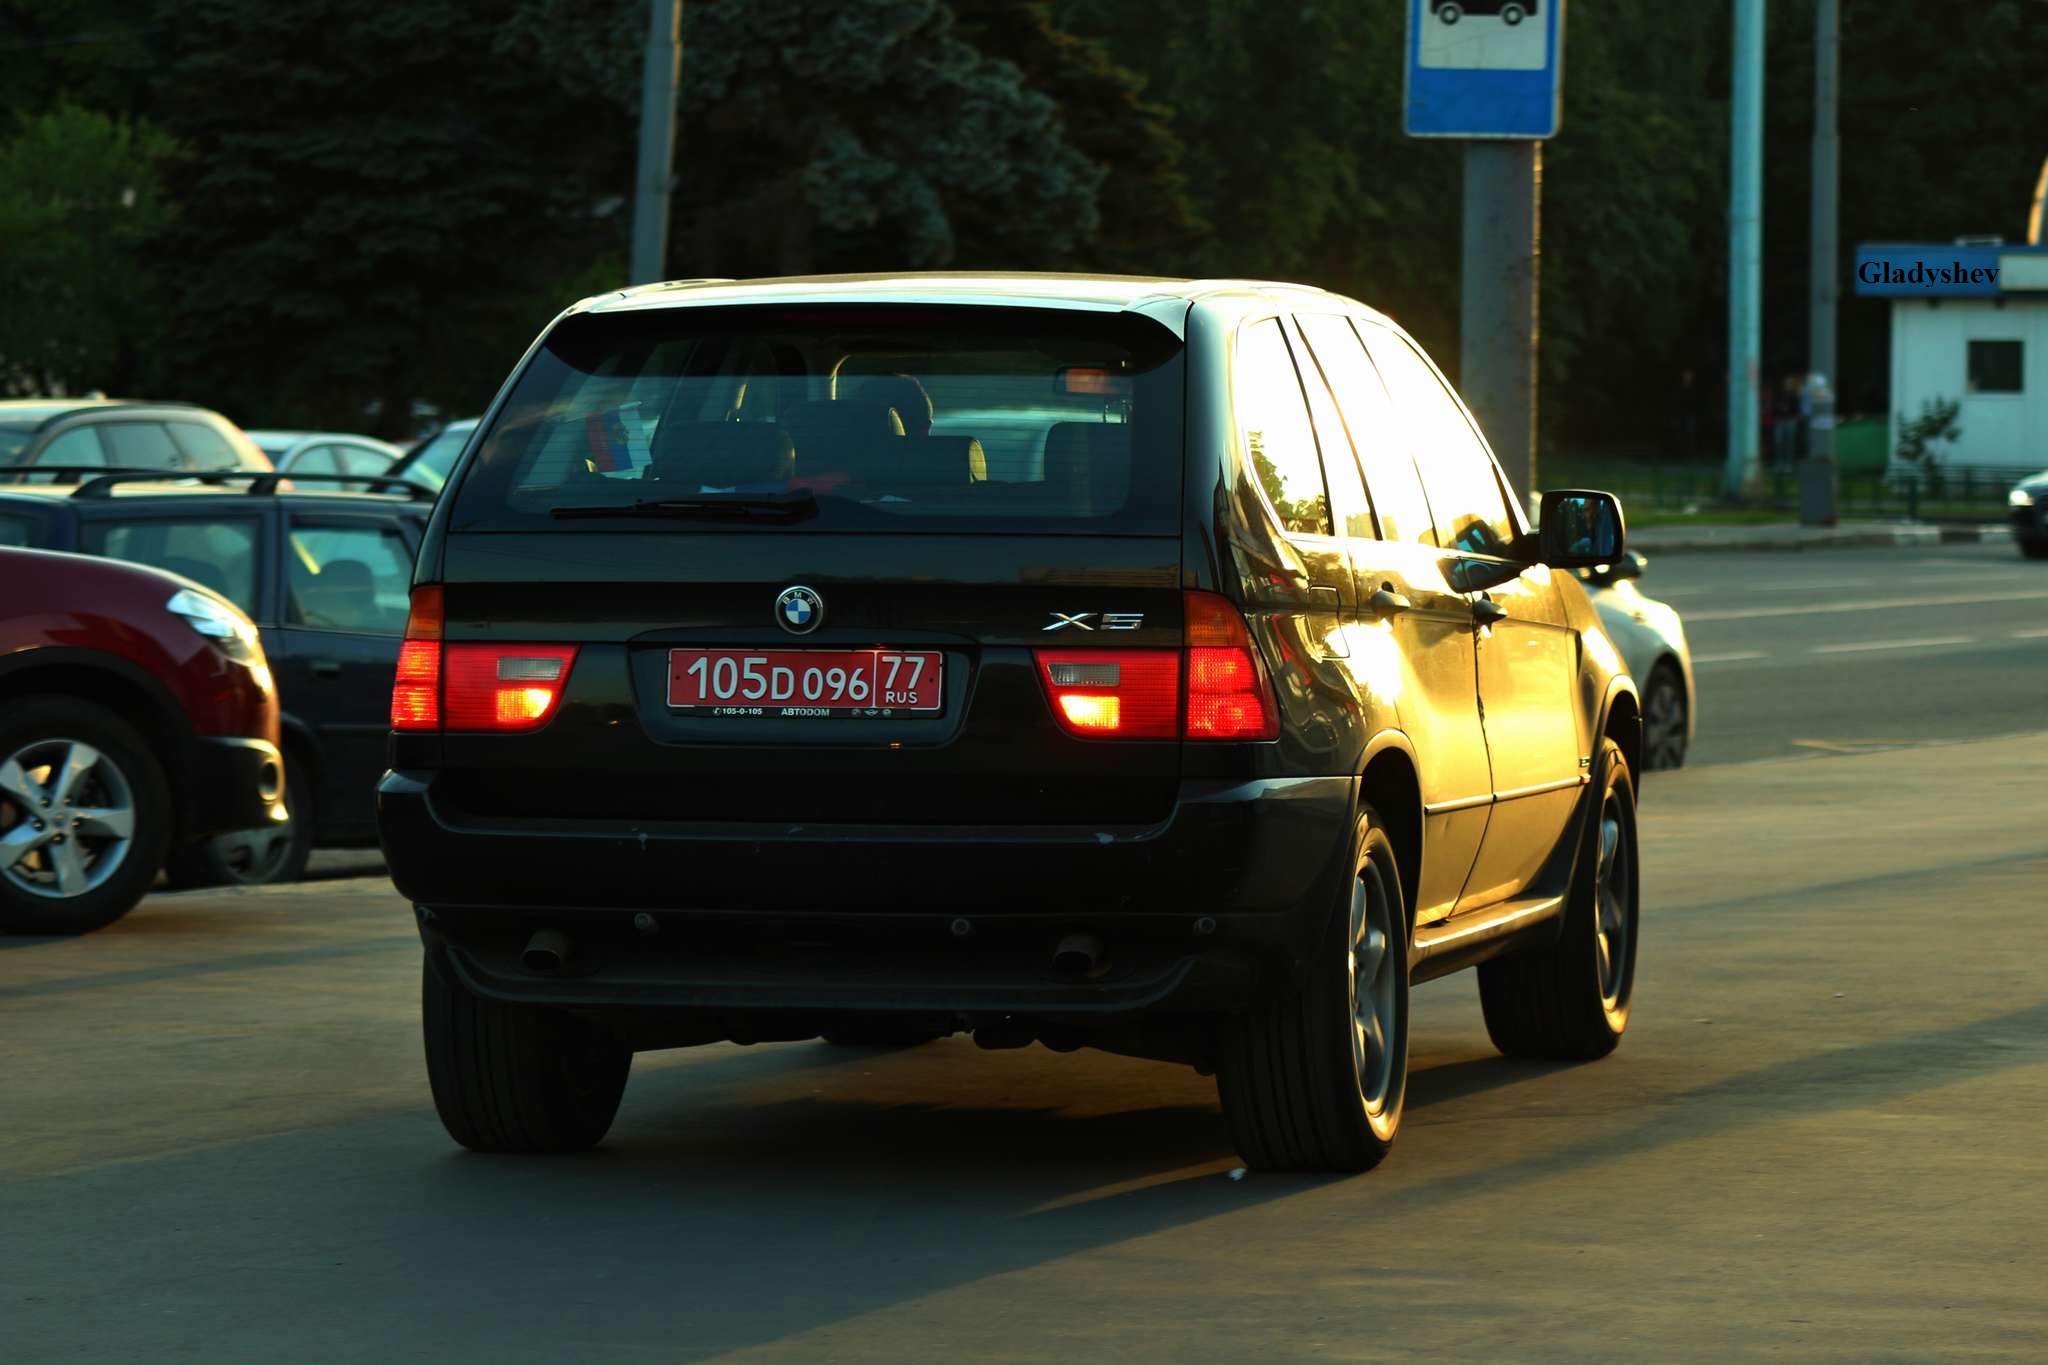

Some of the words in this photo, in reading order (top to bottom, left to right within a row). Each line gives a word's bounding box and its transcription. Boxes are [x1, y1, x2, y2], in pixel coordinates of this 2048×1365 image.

[1042, 612, 1144, 631] X5
[882, 656, 925, 689] 77
[885, 691, 918, 704] RUS
